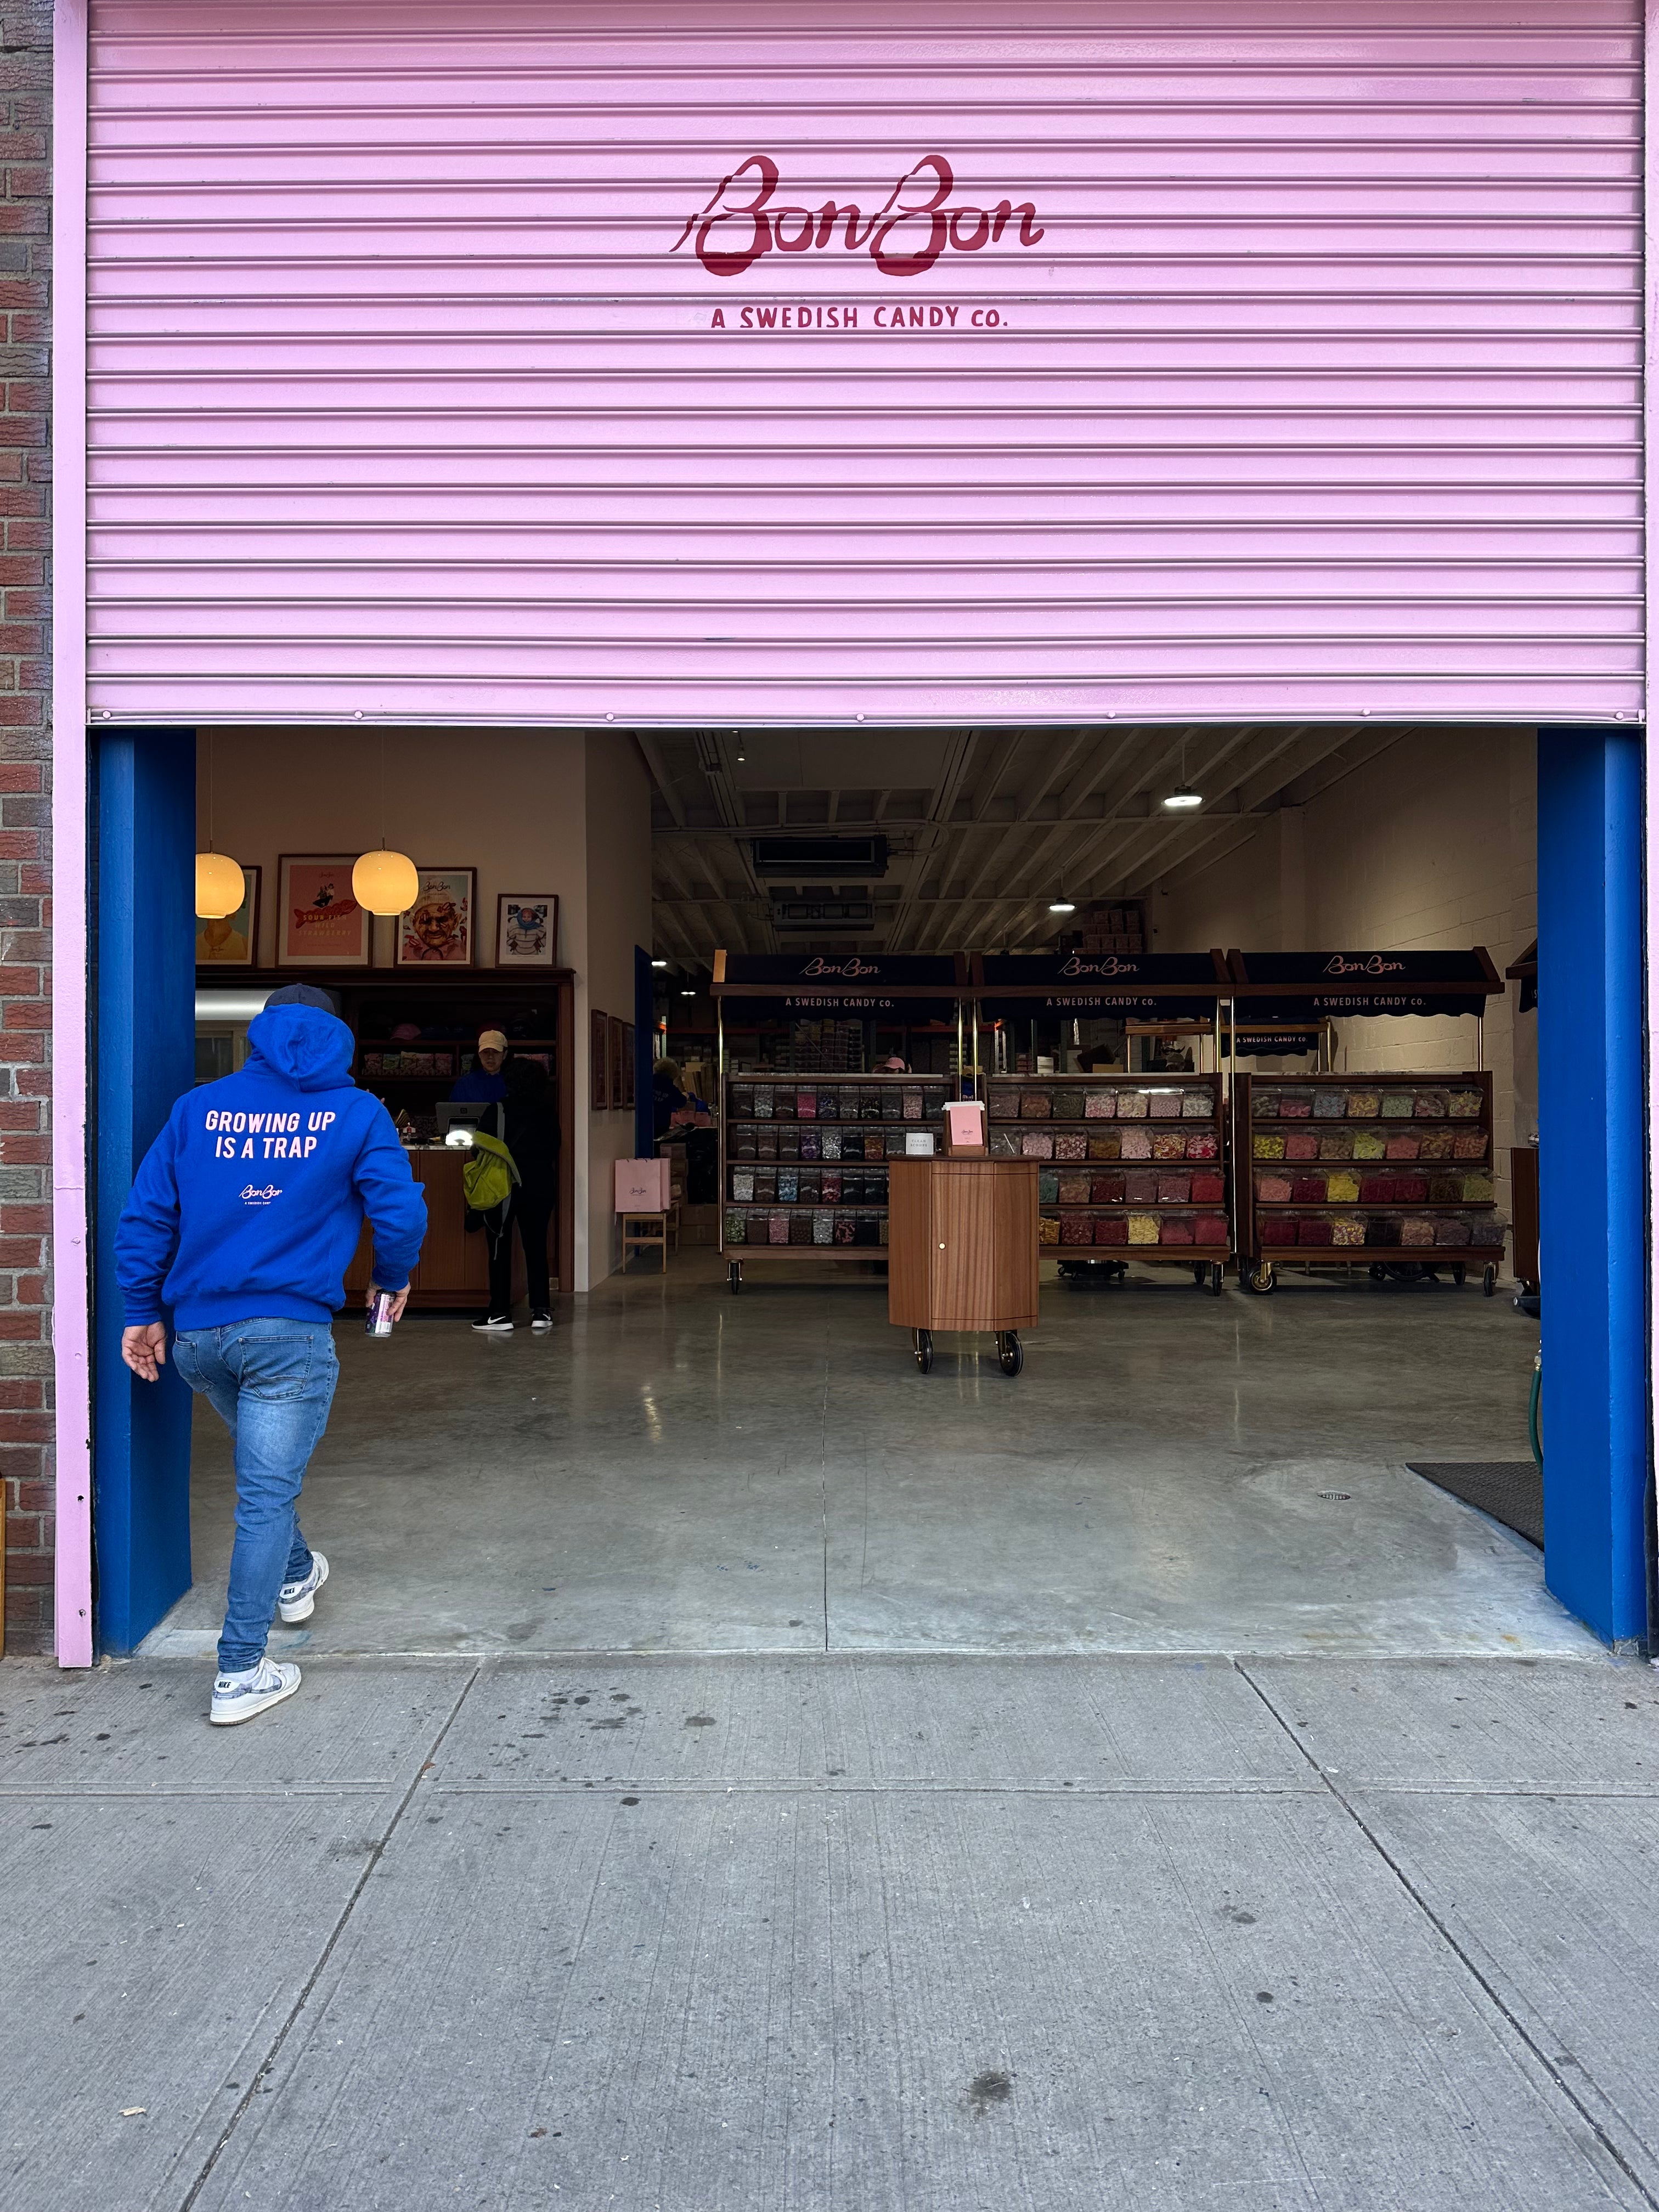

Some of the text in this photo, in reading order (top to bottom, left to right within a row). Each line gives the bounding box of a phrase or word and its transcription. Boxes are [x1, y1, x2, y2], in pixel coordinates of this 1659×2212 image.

[711, 308, 725, 328] A
[740, 307, 858, 328] SWEDISH
[873, 306, 959, 328] CANDY
[785, 997, 792, 1006] A
[795, 997, 839, 1007] SWEDISH
[843, 998, 876, 1007] CANDY
[1046, 997, 1053, 1006] A
[1056, 997, 1101, 1006] SWEDISH
[1105, 997, 1138, 1006] CANDY
[1313, 997, 1319, 1006] A
[1323, 997, 1369, 1006] SWEDISH
[1374, 997, 1407, 1006] CANDY
[205, 1110, 336, 1133] GROWING UP
[215, 1136, 317, 1159] IS A TRAP
[284, 1587, 295, 1595] NIKE
